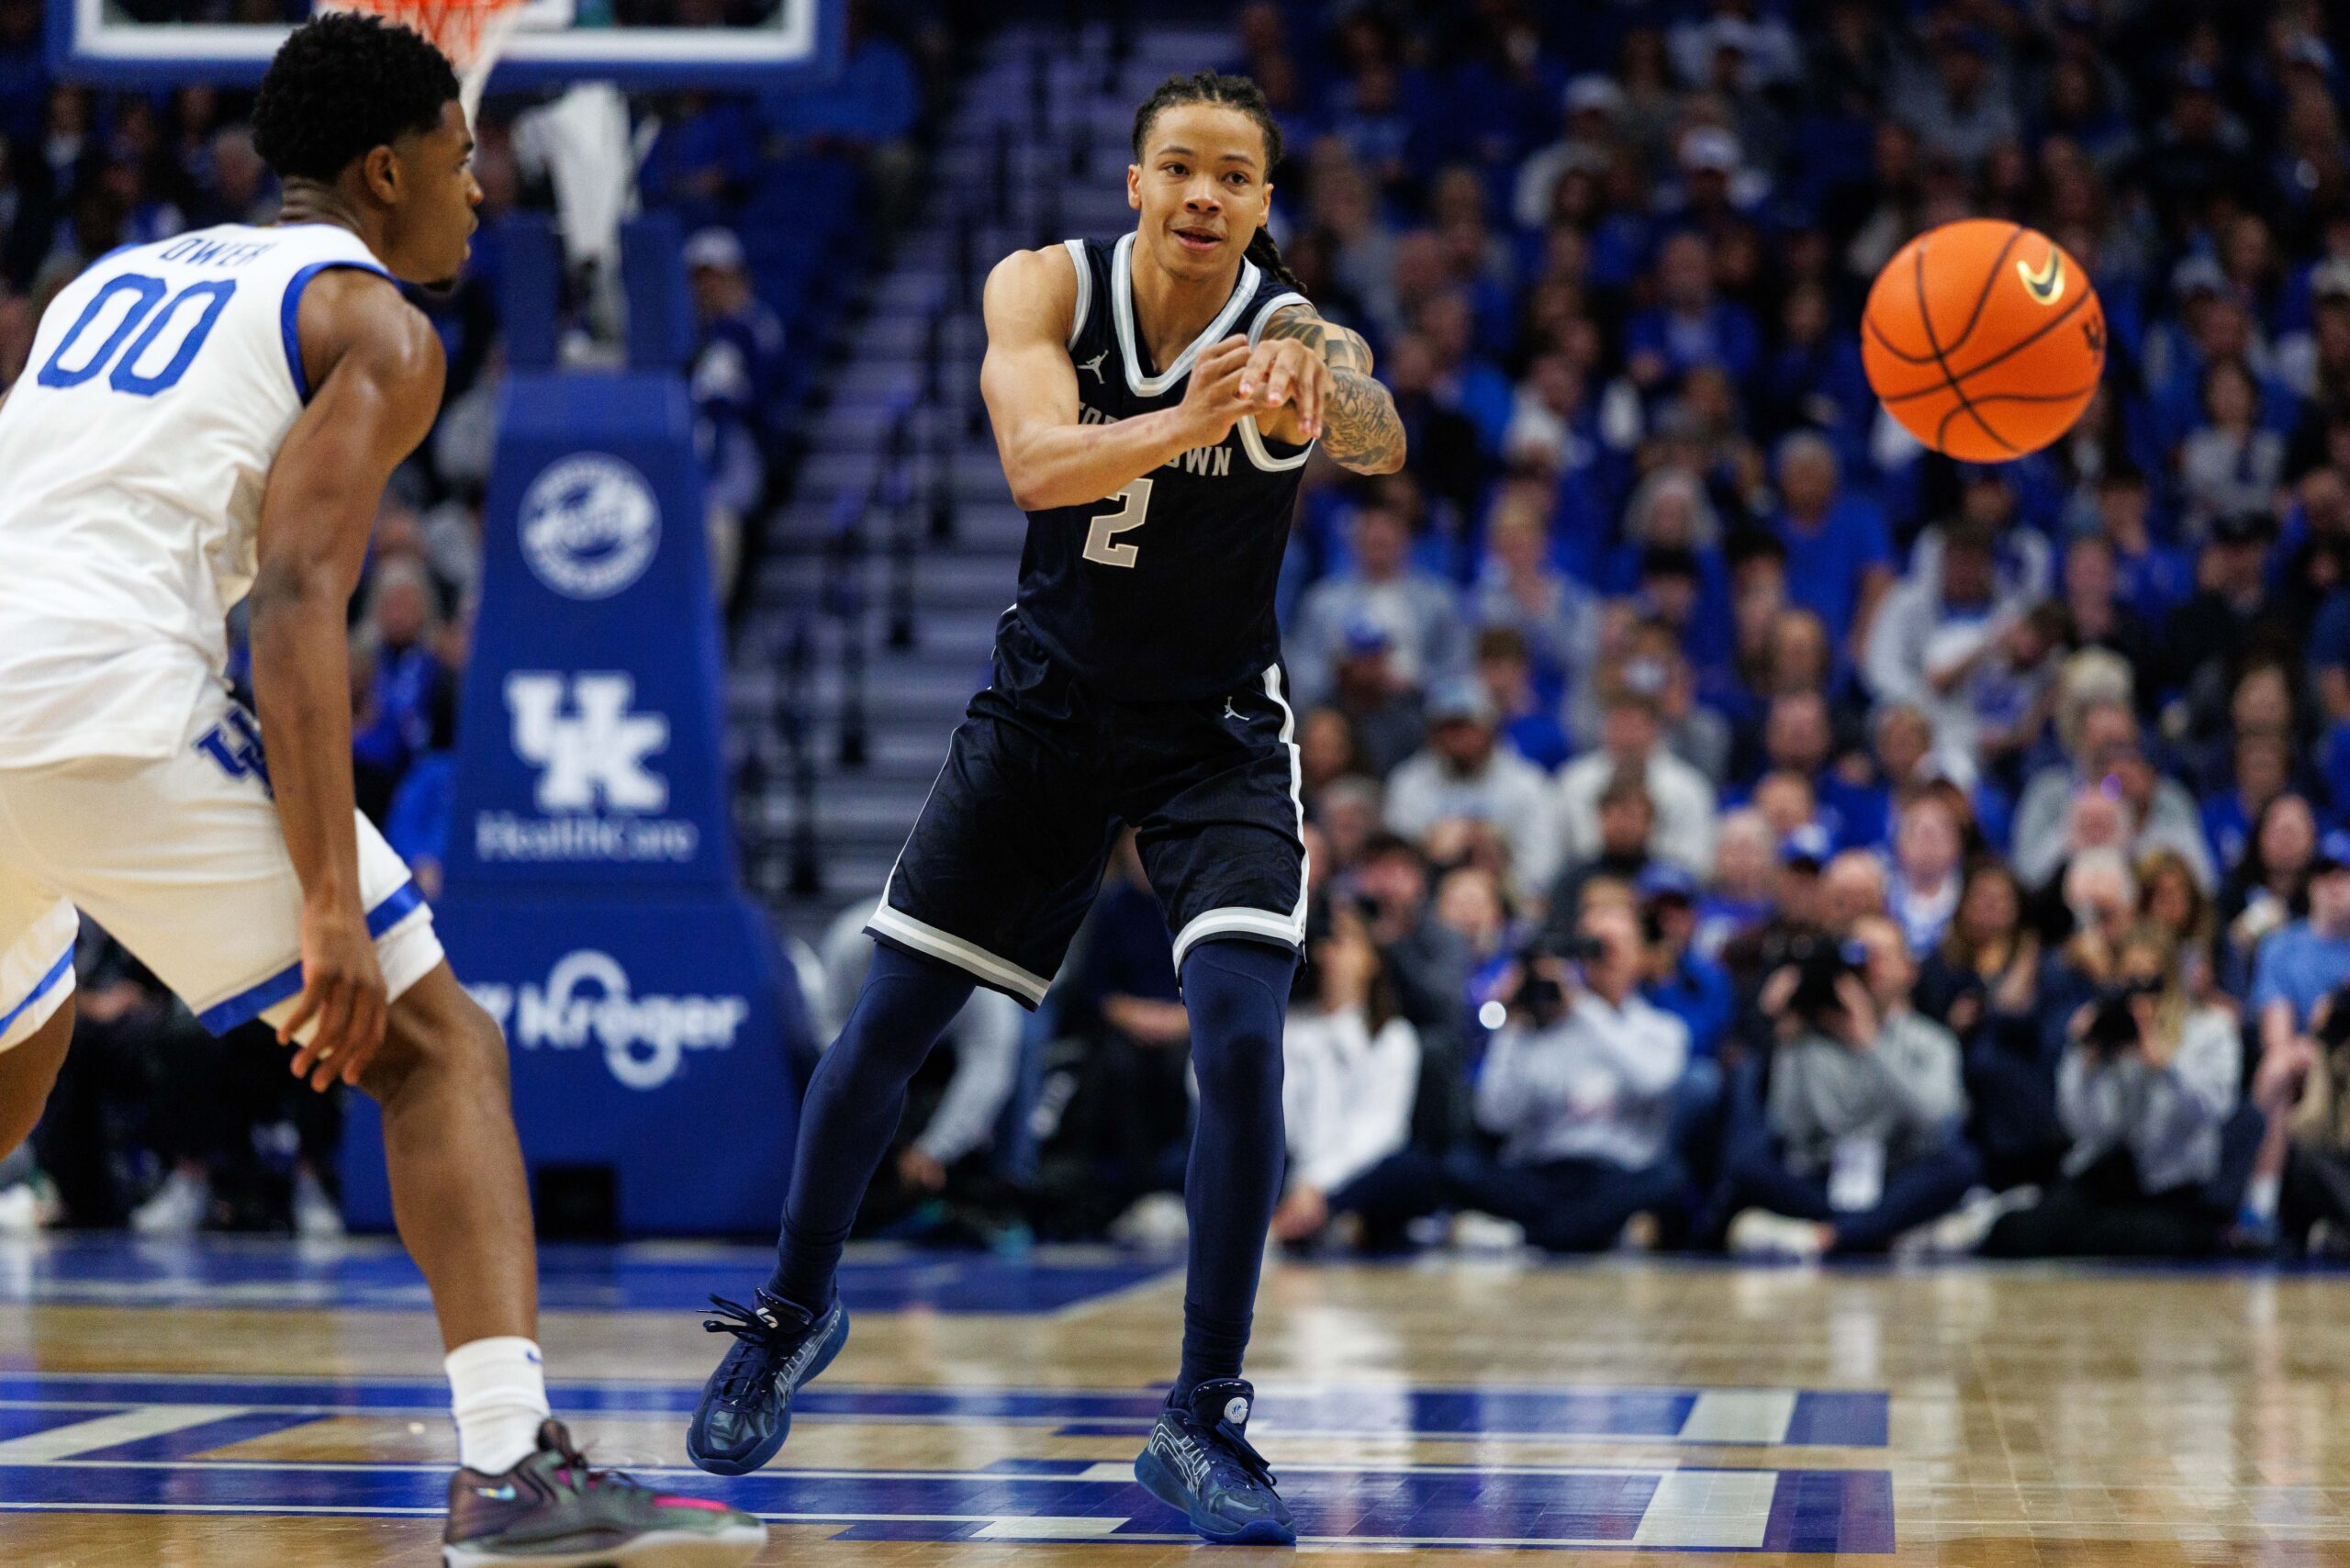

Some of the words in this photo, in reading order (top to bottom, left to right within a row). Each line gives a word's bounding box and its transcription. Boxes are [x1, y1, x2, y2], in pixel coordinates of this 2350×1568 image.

[38, 273, 237, 397] 00
[1082, 478, 1153, 568] 2
[504, 672, 669, 812] UK
[516, 949, 748, 1090] Kroger
